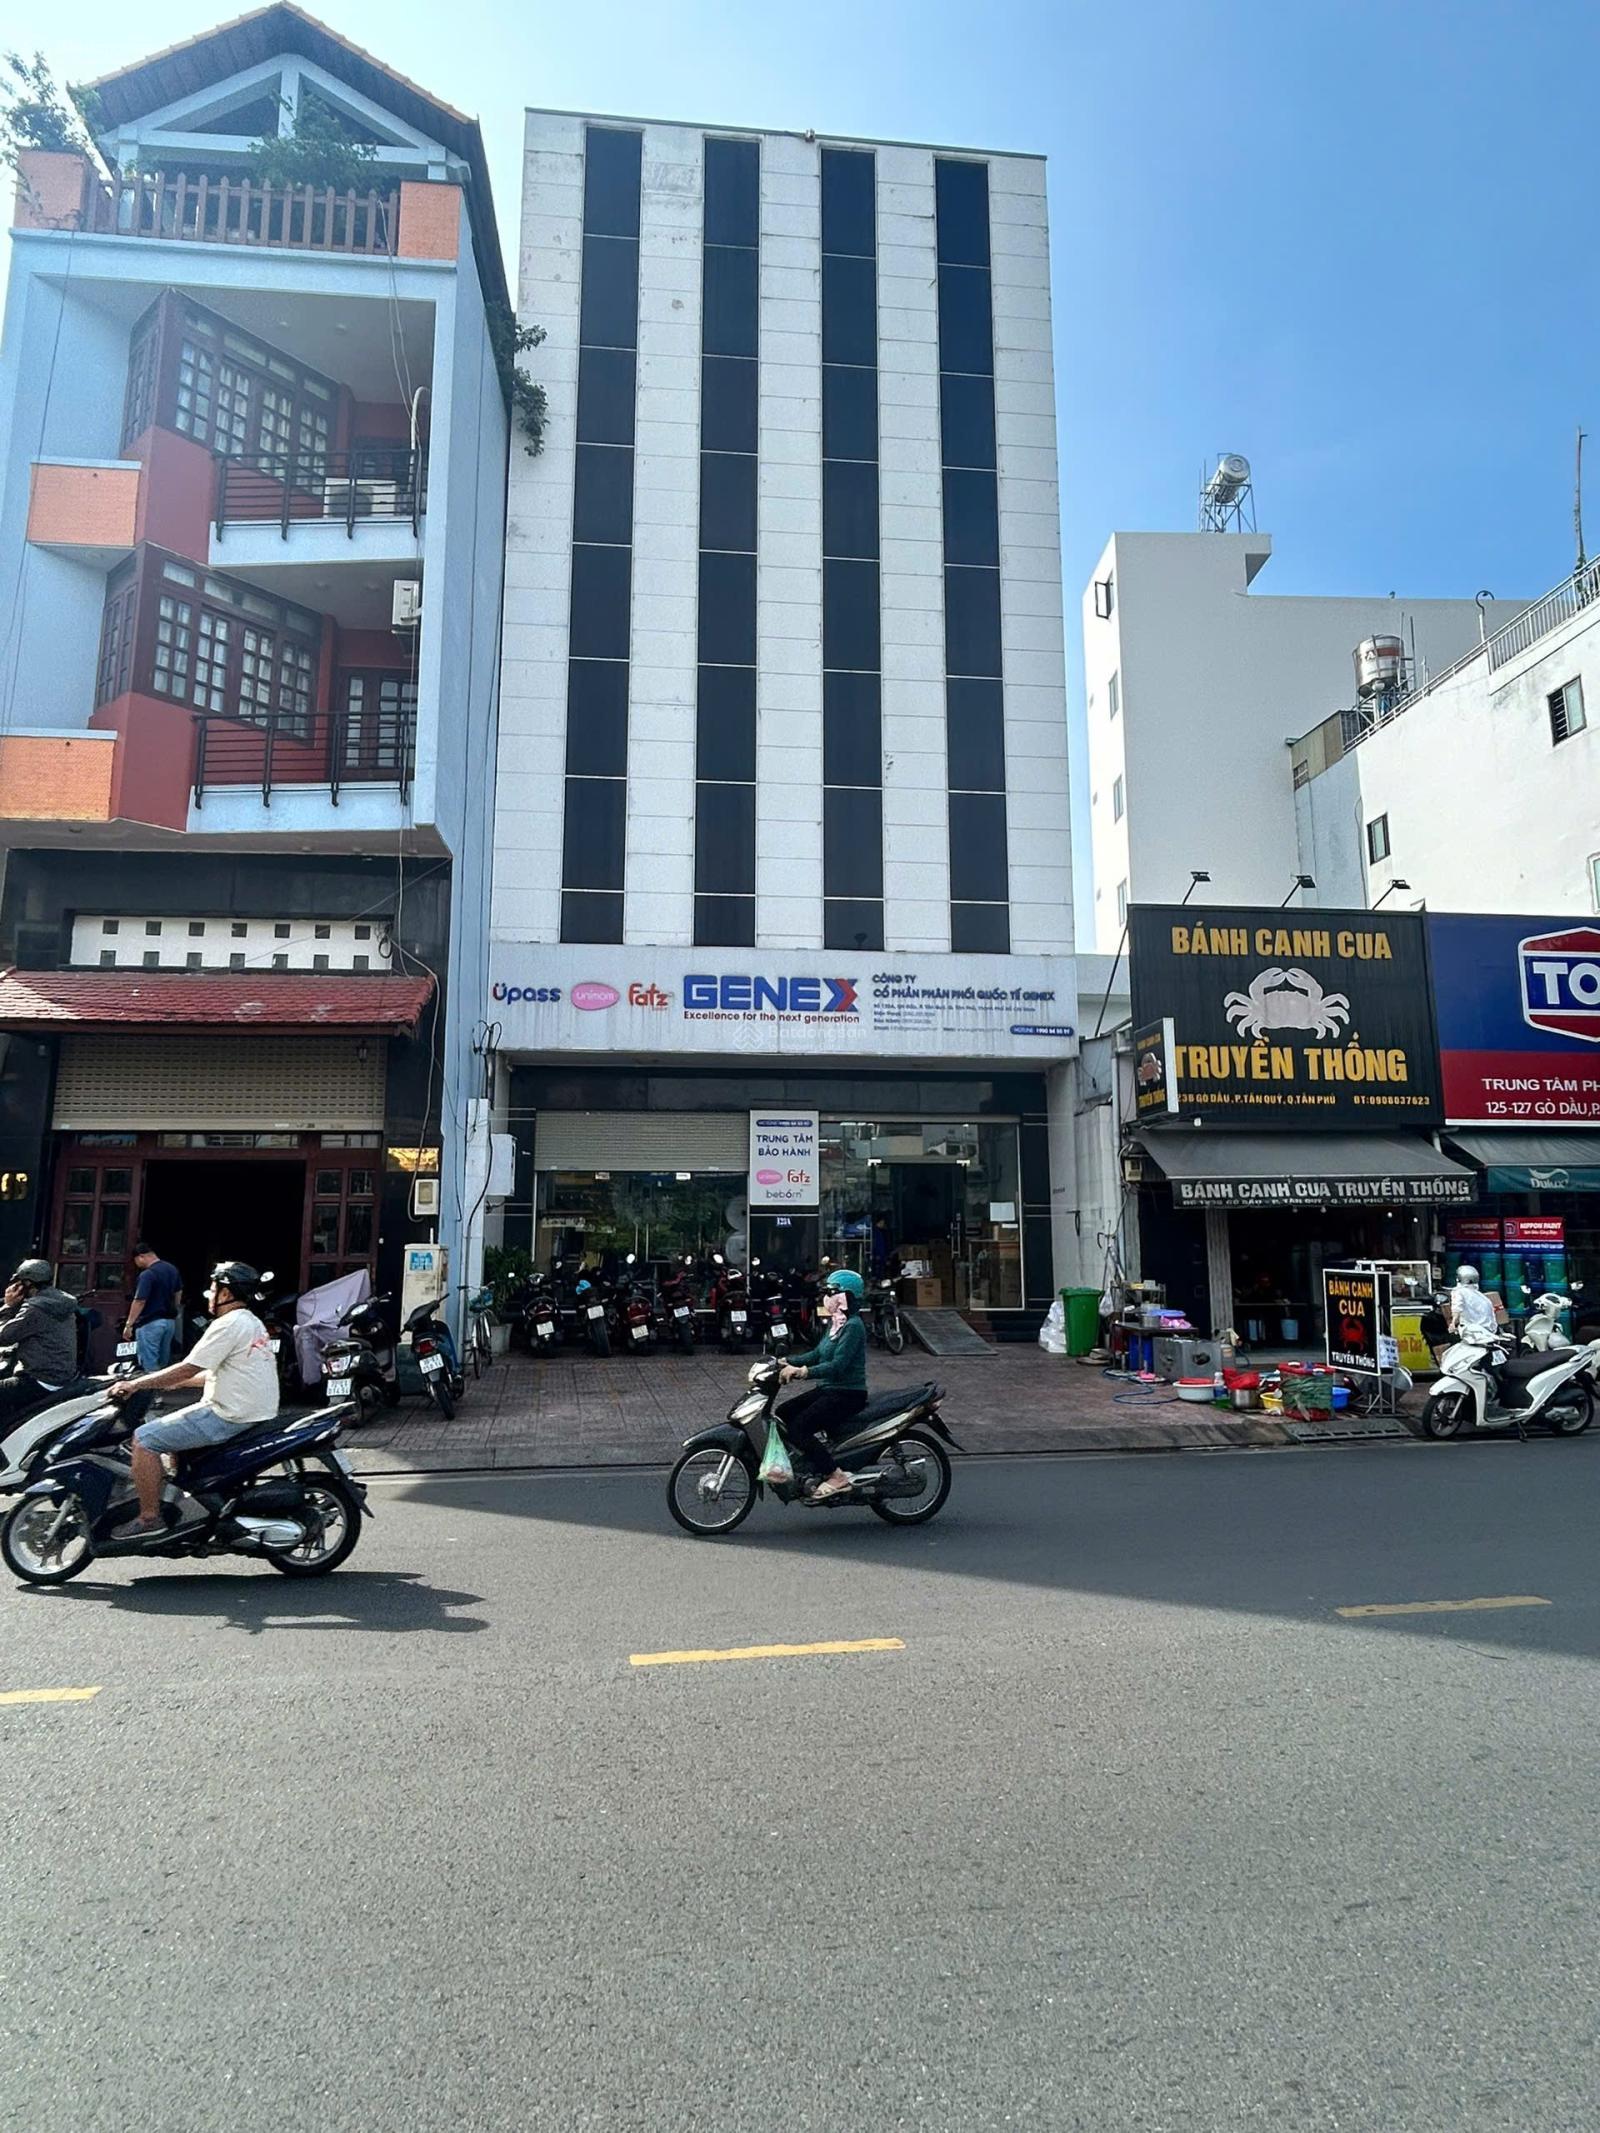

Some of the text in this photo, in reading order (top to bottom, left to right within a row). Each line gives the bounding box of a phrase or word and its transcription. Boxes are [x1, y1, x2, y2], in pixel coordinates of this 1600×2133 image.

[1171, 921, 1393, 960] BÁNH CANH CUA
[872, 972, 916, 983] CÔNG TY
[684, 974, 858, 1012] GENEX
[684, 1011, 860, 1024] Excellence for the next generation
[1176, 1031, 1408, 1082] TRUYỀN THỐNG
[1482, 1078, 1540, 1091] TRUNG
[1543, 1076, 1578, 1092] TÂM
[1485, 1101, 1532, 1114] 125-127
[1535, 1098, 1556, 1115] GÒ
[756, 1132, 813, 1143] TRUNG TÂM
[782, 1146, 811, 1156] HÀNH
[1180, 1180, 1233, 1198] BÁNH
[1238, 1182, 1291, 1198] CANH
[1294, 1182, 1331, 1197] CUA
[1409, 1176, 1469, 1196] THỐNG
[1530, 1178, 1566, 1189] Dulux
[1328, 1277, 1373, 1298] BÁNH CANH
[1339, 1299, 1365, 1317] CUA
